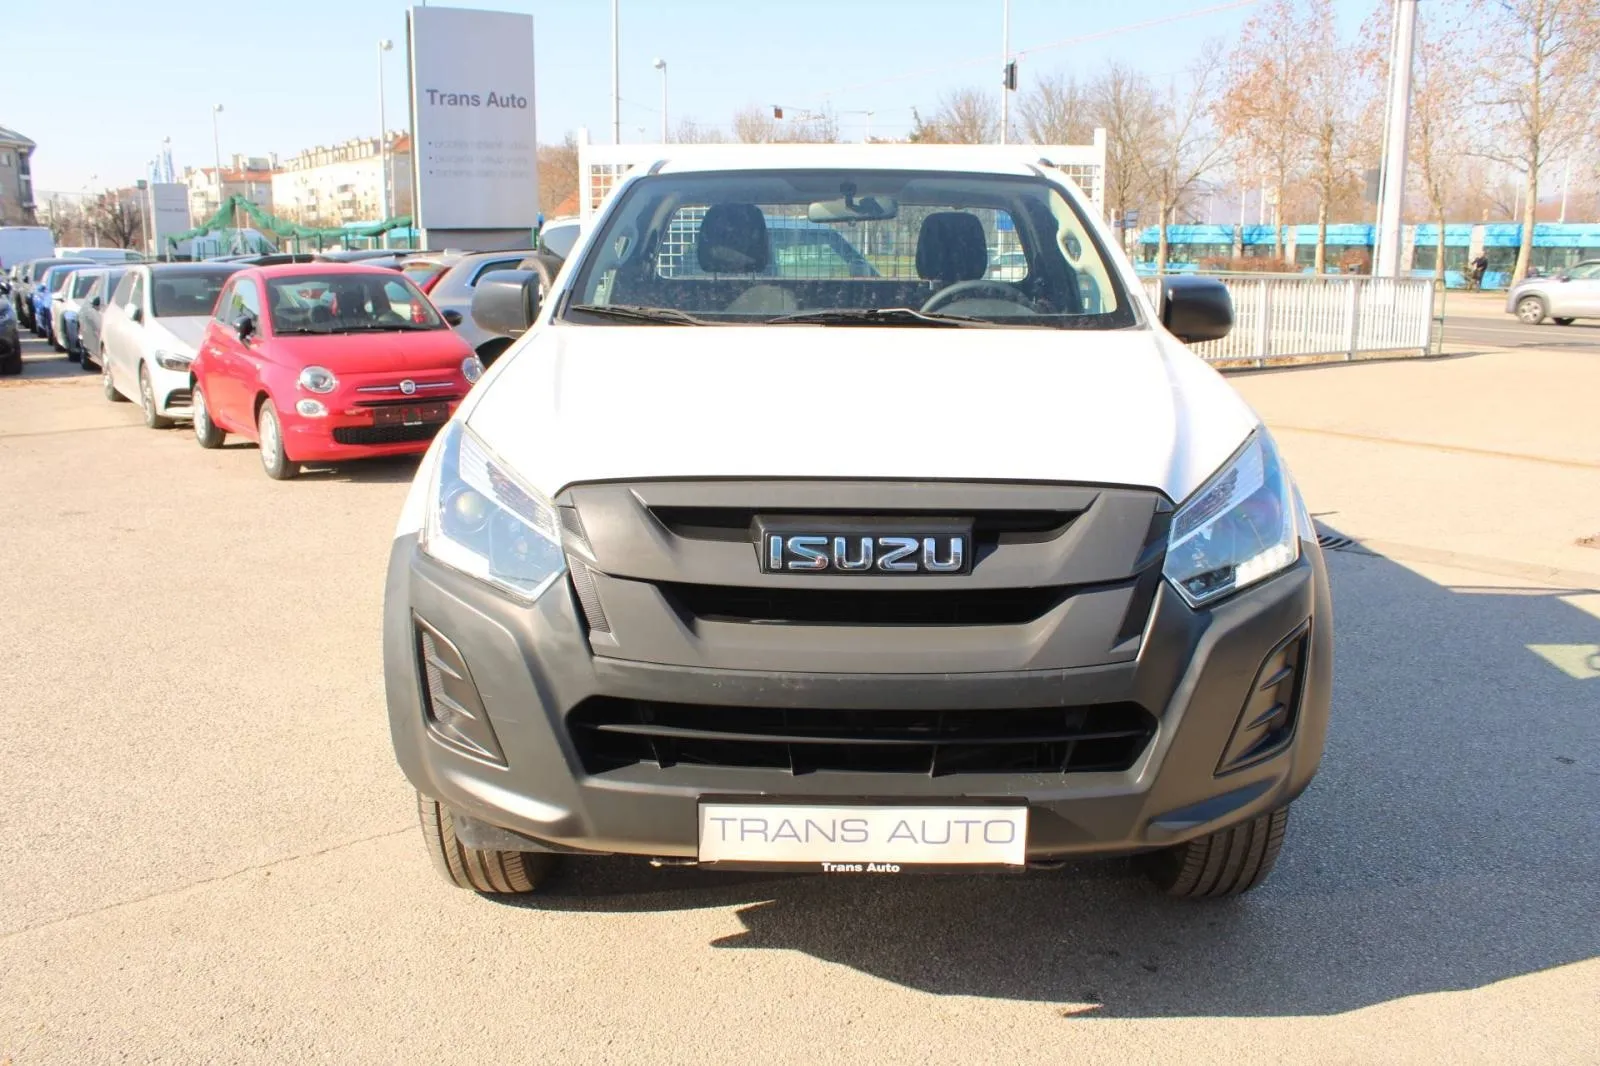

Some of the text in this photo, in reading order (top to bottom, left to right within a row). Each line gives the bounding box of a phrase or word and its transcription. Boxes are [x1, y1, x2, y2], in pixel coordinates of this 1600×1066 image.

[426, 89, 527, 108] Trans Auto
[770, 535, 963, 571] ISUZU
[710, 817, 1015, 844] TRANS AUTO
[821, 862, 901, 873] Trans Auto
